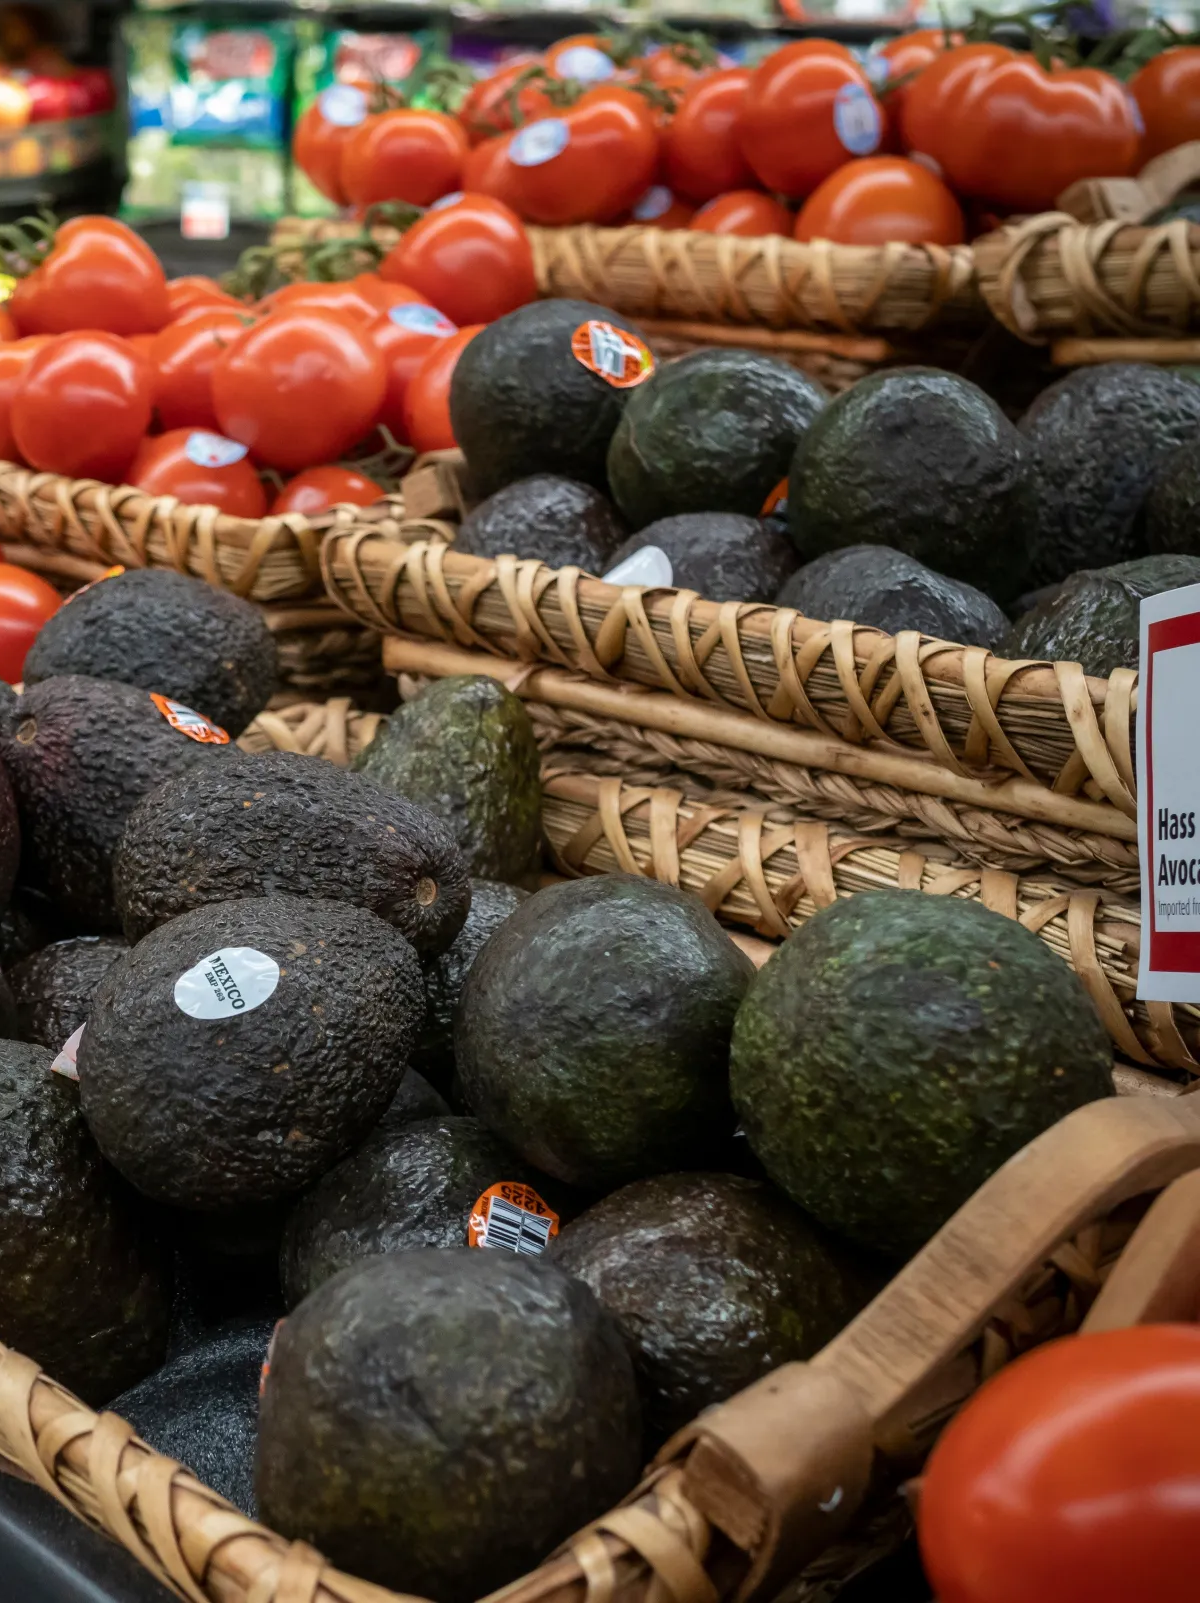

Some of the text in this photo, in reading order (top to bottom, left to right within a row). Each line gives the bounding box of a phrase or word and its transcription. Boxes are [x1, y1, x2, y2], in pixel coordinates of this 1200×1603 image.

[1158, 807, 1196, 841] Hass
[1158, 897, 1190, 922] Imported
[204, 971, 218, 988] EMP
[208, 955, 246, 1010] MEXICO
[501, 1185, 547, 1215] 4225
